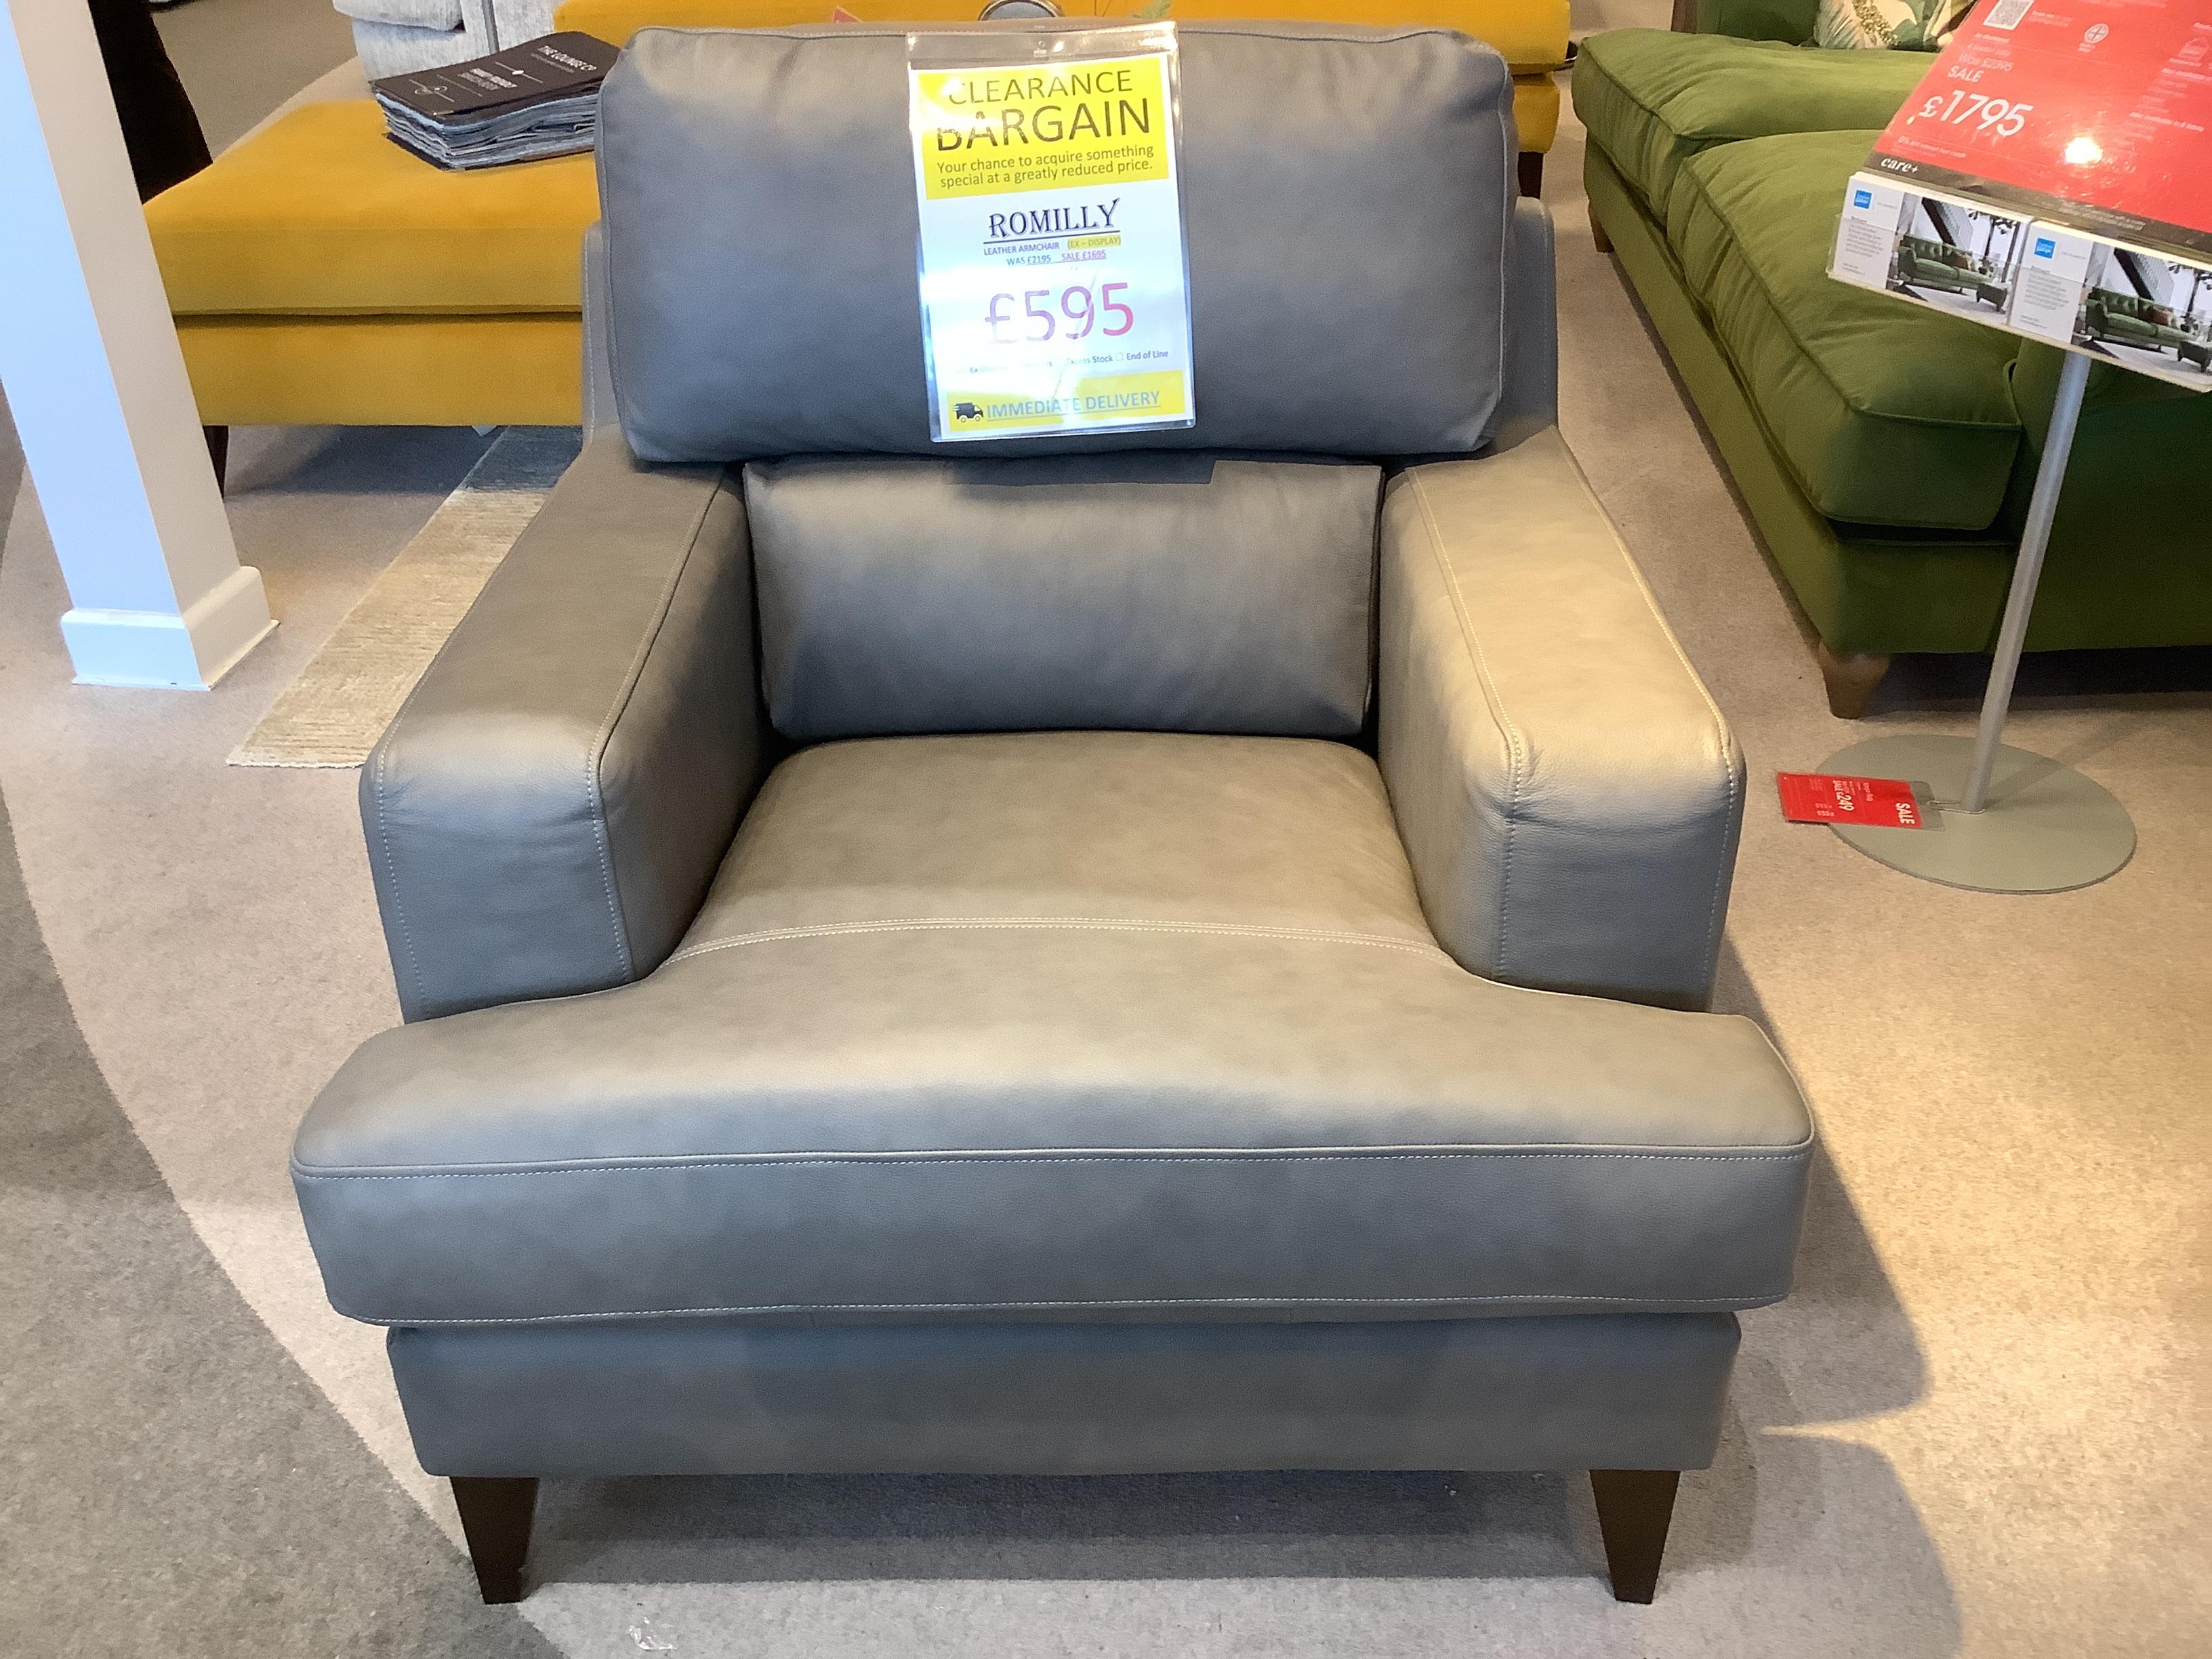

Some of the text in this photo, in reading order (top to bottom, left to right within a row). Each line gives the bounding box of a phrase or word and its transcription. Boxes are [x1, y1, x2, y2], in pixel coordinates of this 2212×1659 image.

[1948, 65, 1984, 83] SALE
[937, 98, 1150, 151] BARGAIN
[1919, 89, 2034, 137] £1795
[937, 145, 1154, 173] Your chance to acquire something
[1881, 157, 1919, 173] care+
[941, 159, 1153, 190] special at a greatly reduced price.
[988, 197, 1121, 240] ROMILLY
[983, 244, 1017, 255] LEATHER
[1019, 241, 1060, 253] ARMCHAIR
[1006, 249, 1107, 266] WAS £2195 SALE £1695
[985, 282, 1134, 344] £595
[1092, 354, 1113, 364] Stock
[1126, 351, 1141, 361] End
[1143, 350, 1151, 359] of
[1153, 350, 1169, 359] Line
[987, 390, 1160, 418] IMMEDIATE DELIVERY
[1896, 802, 1916, 825] SALE
